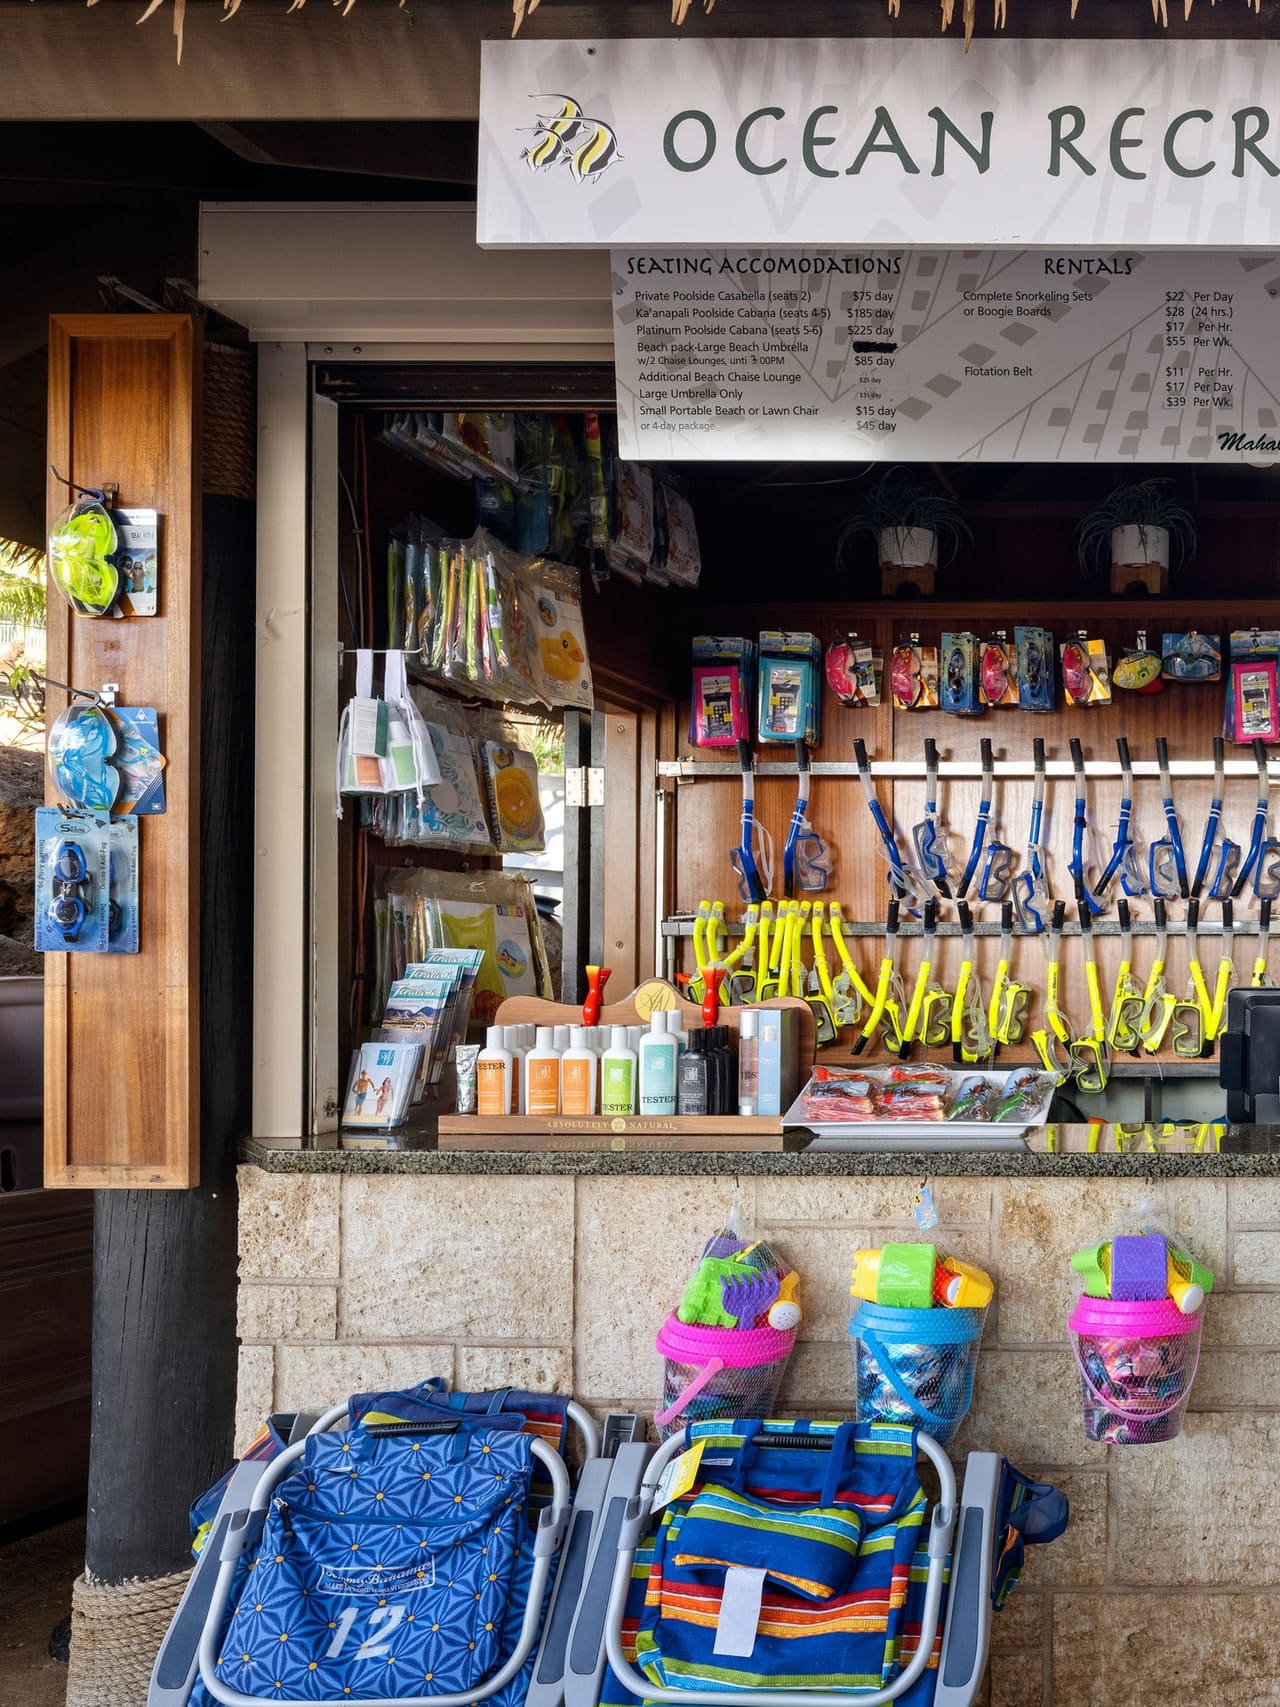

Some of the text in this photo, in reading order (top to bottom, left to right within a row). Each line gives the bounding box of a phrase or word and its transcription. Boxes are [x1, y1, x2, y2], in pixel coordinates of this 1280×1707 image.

[662, 102, 995, 188] OCEAN
[627, 257, 901, 275] SEATING ACCOMODATIONS
[1044, 258, 1133, 275] RENTALS
[635, 290, 893, 304] Private Poolside Casabella (seats 2) $75 day
[963, 291, 1092, 303] Complete Snorkeling Sets
[1166, 291, 1233, 304] $22 Per Day
[636, 307, 894, 320] Ka'anapali Poolside Cabana (seats 4-5) $185 day
[963, 306, 1051, 318] or Boogie Boards
[1166, 306, 1233, 319] $28 (24 hrs.)
[637, 325, 894, 338] Platinum Poolside Cabana (seats 5-6) $225 day
[1166, 320, 1233, 332] $17 Per Hr.
[1166, 336, 1233, 347] $55 Per Wk.
[638, 342, 808, 354] Beach pack-Large Beach Umbrella
[855, 355, 895, 368] $85 day
[965, 366, 1032, 376] Flotation Belt
[1166, 367, 1233, 377] $11 Per Hr.
[639, 372, 801, 384] Additional Beach Chaise Lounge
[1166, 382, 1233, 393] $17 Per Day
[640, 389, 743, 401] Large Umbrella Only
[1167, 397, 1233, 407] $39 Per Wk.
[640, 405, 667, 415] Small
[670, 406, 712, 415] Portable
[715, 406, 745, 415] Beach
[763, 406, 790, 415] Lawn
[793, 406, 819, 415] Chair
[856, 406, 874, 416] $15
[877, 406, 896, 418] day
[326, 1605, 406, 1660] 12
